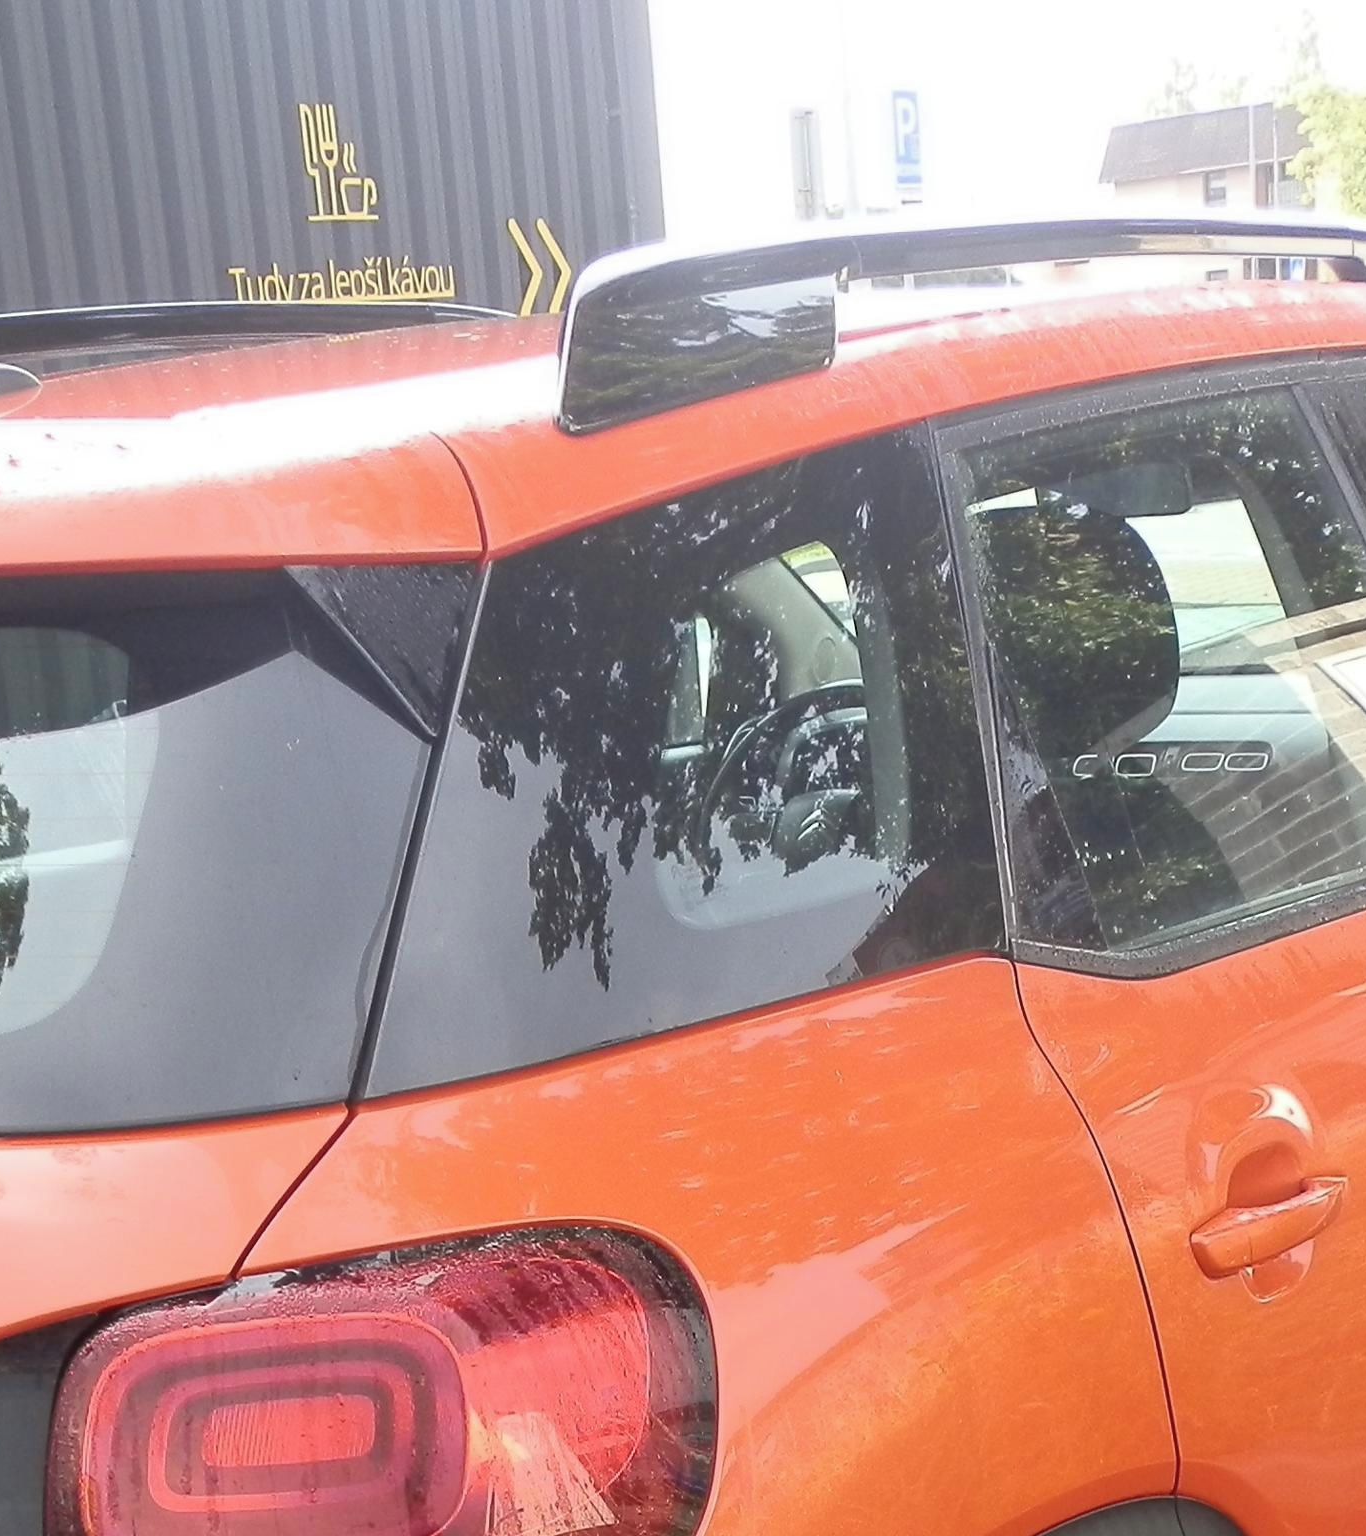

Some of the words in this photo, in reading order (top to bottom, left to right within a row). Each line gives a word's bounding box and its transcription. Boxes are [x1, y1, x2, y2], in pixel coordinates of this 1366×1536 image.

[896, 97, 917, 157] P
[228, 262, 294, 302] Tudy
[298, 271, 326, 301] za
[386, 255, 455, 300] kávou
